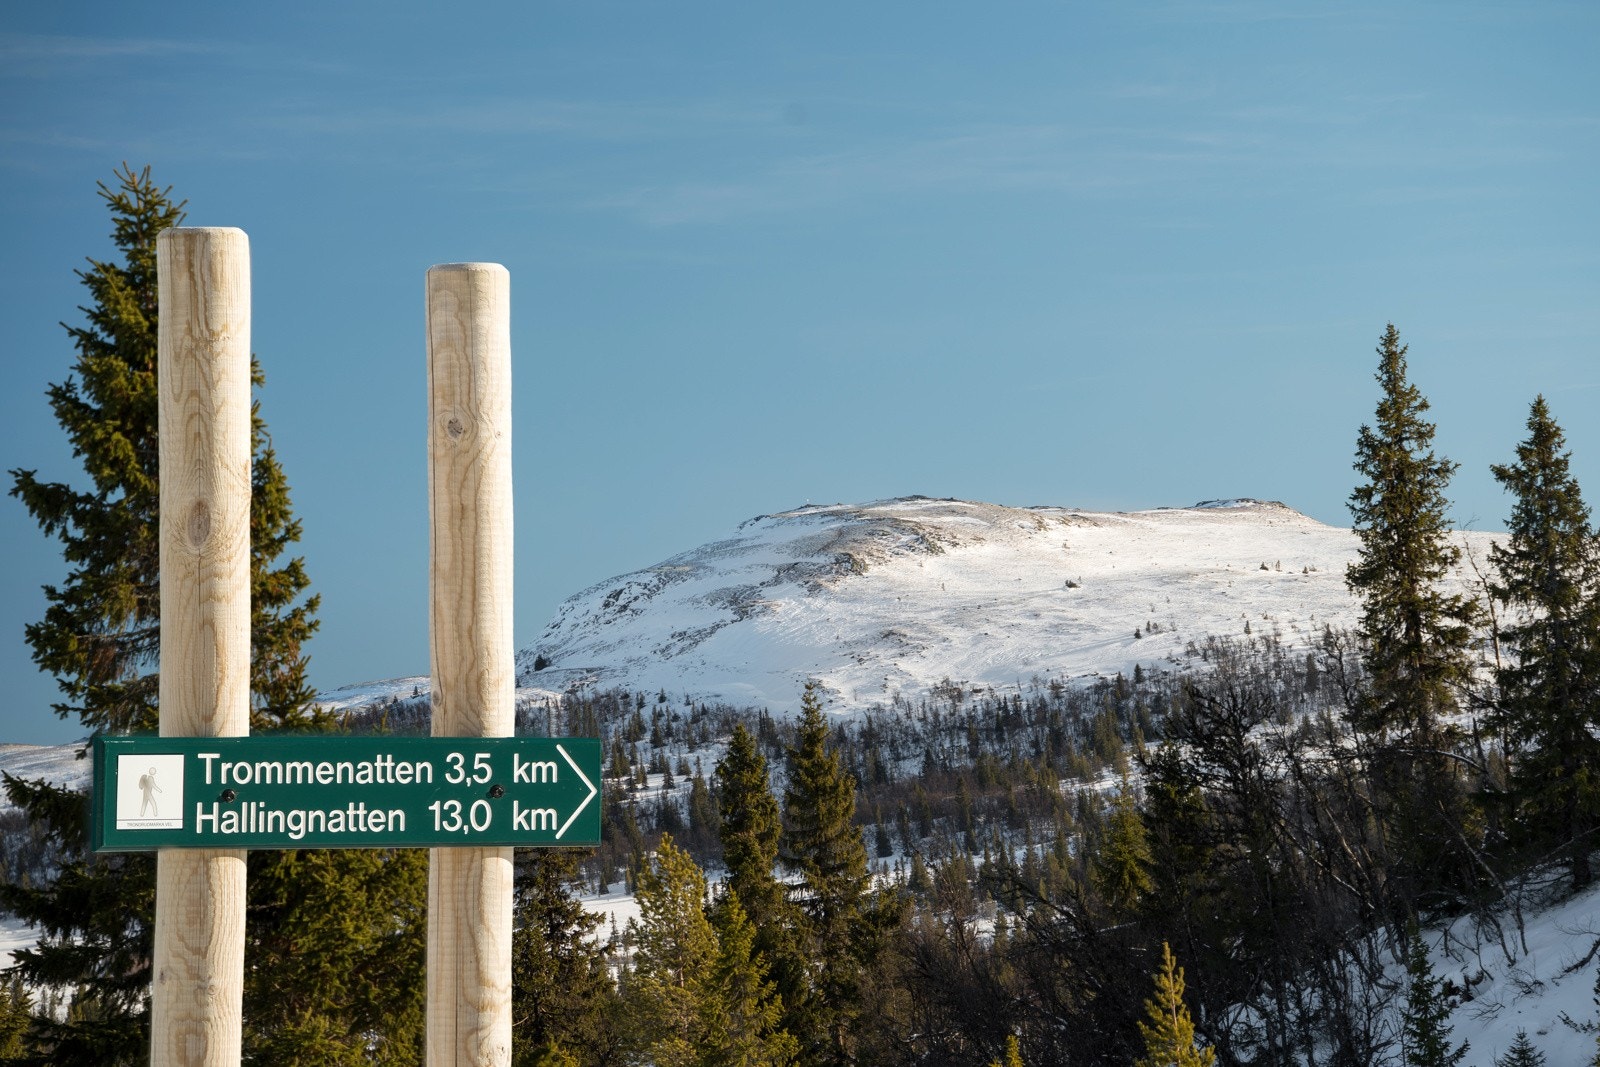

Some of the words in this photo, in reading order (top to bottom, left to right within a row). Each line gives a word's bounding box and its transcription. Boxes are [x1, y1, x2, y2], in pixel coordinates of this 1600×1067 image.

[197, 752, 433, 785] Trommenatten
[444, 752, 493, 787] 3,5
[513, 752, 558, 784] km
[195, 801, 406, 840] Hallingnatten
[428, 799, 493, 834] 13,0
[512, 799, 558, 831] km
